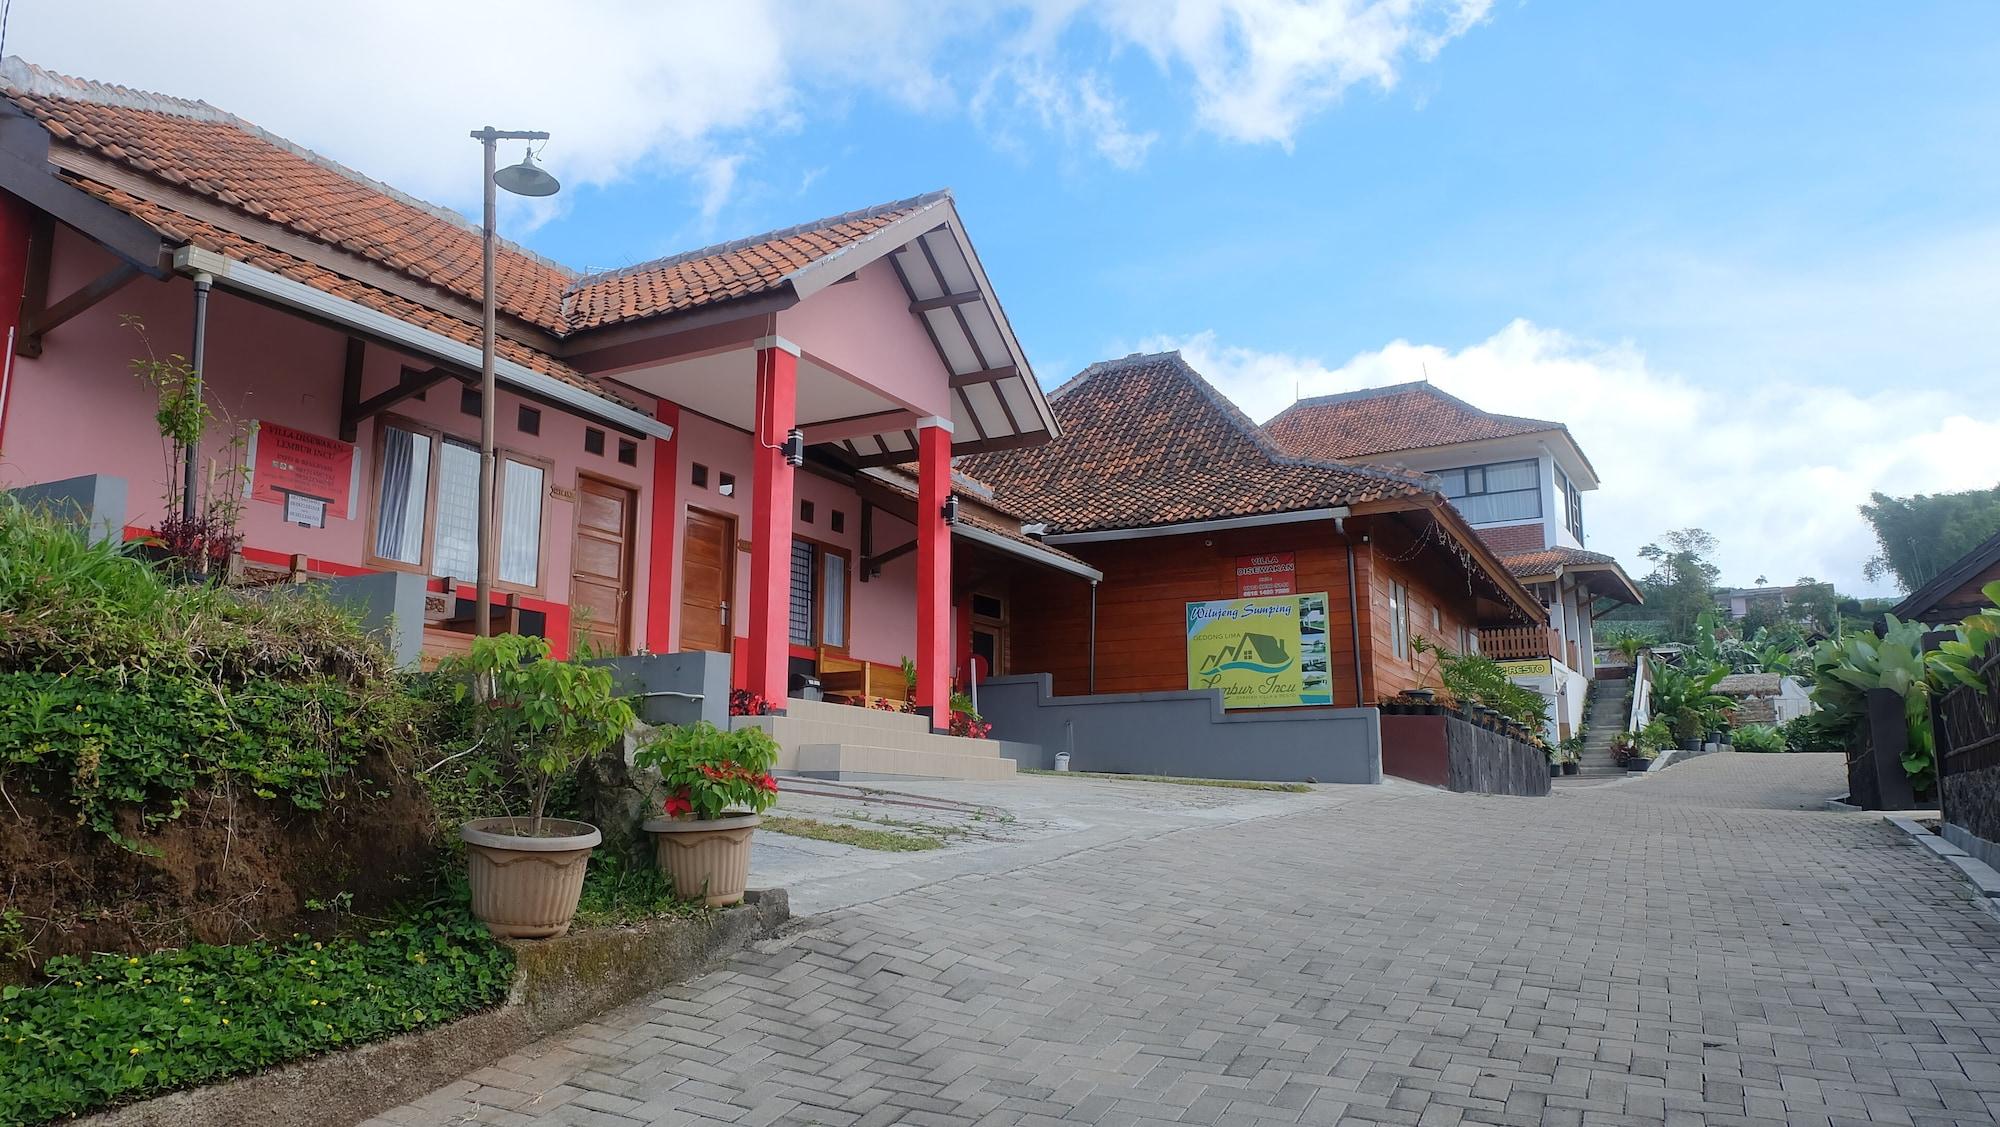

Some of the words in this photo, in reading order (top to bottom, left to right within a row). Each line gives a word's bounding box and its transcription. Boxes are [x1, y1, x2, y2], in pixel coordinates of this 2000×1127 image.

[268, 425, 294, 439] VILLA
[276, 440, 312, 456] LEMBUR
[1251, 556, 1279, 565] VILLA
[1237, 563, 1295, 576] DISEWAKAN
[1191, 606, 1239, 620] Wilujeng
[1241, 604, 1291, 618] Sumping
[1225, 632, 1241, 640] LIMA
[1508, 664, 1545, 674] RESTO
[1258, 674, 1296, 694] Incu
